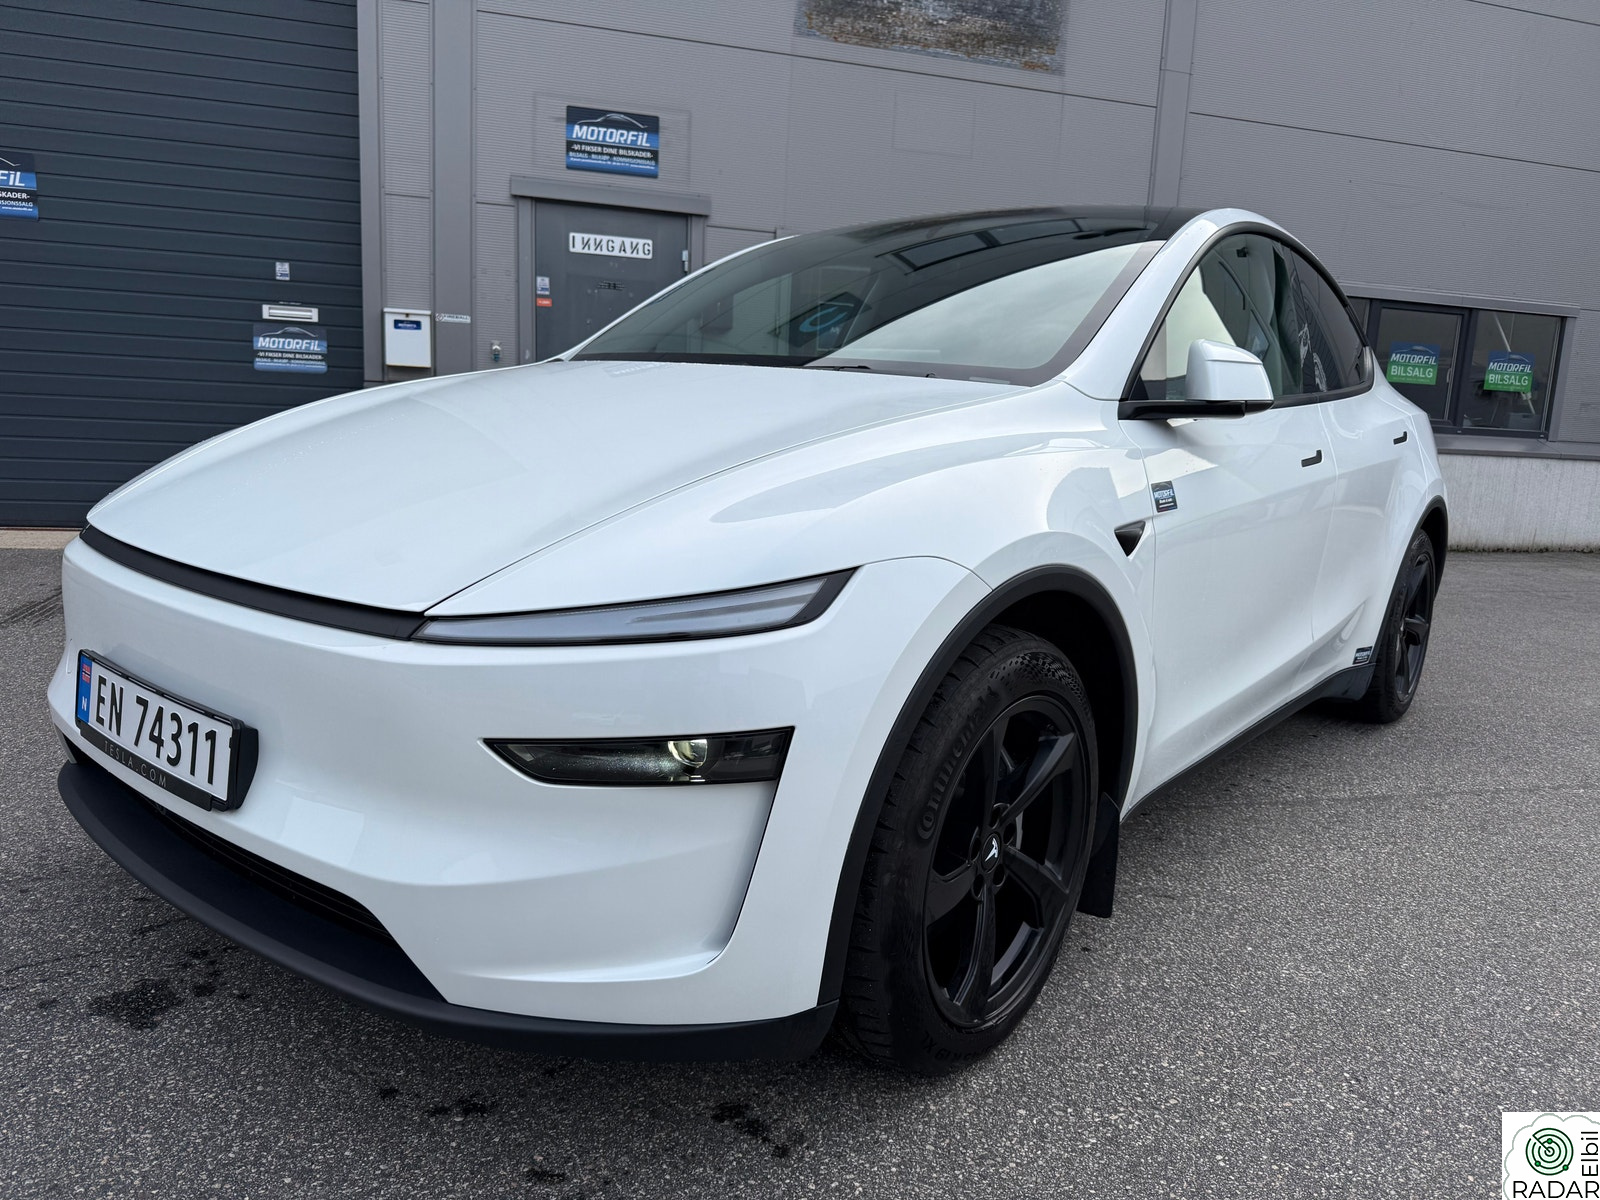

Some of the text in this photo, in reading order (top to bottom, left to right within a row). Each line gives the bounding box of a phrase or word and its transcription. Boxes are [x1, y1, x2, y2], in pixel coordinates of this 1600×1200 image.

[581, 144, 602, 152] FIKSER
[572, 235, 651, 256] INNGANG
[1390, 365, 1433, 378] BILSALG
[1488, 374, 1529, 386] BILSALG
[81, 674, 217, 786] N EN 74311
[104, 740, 168, 788] TESLA.COM
